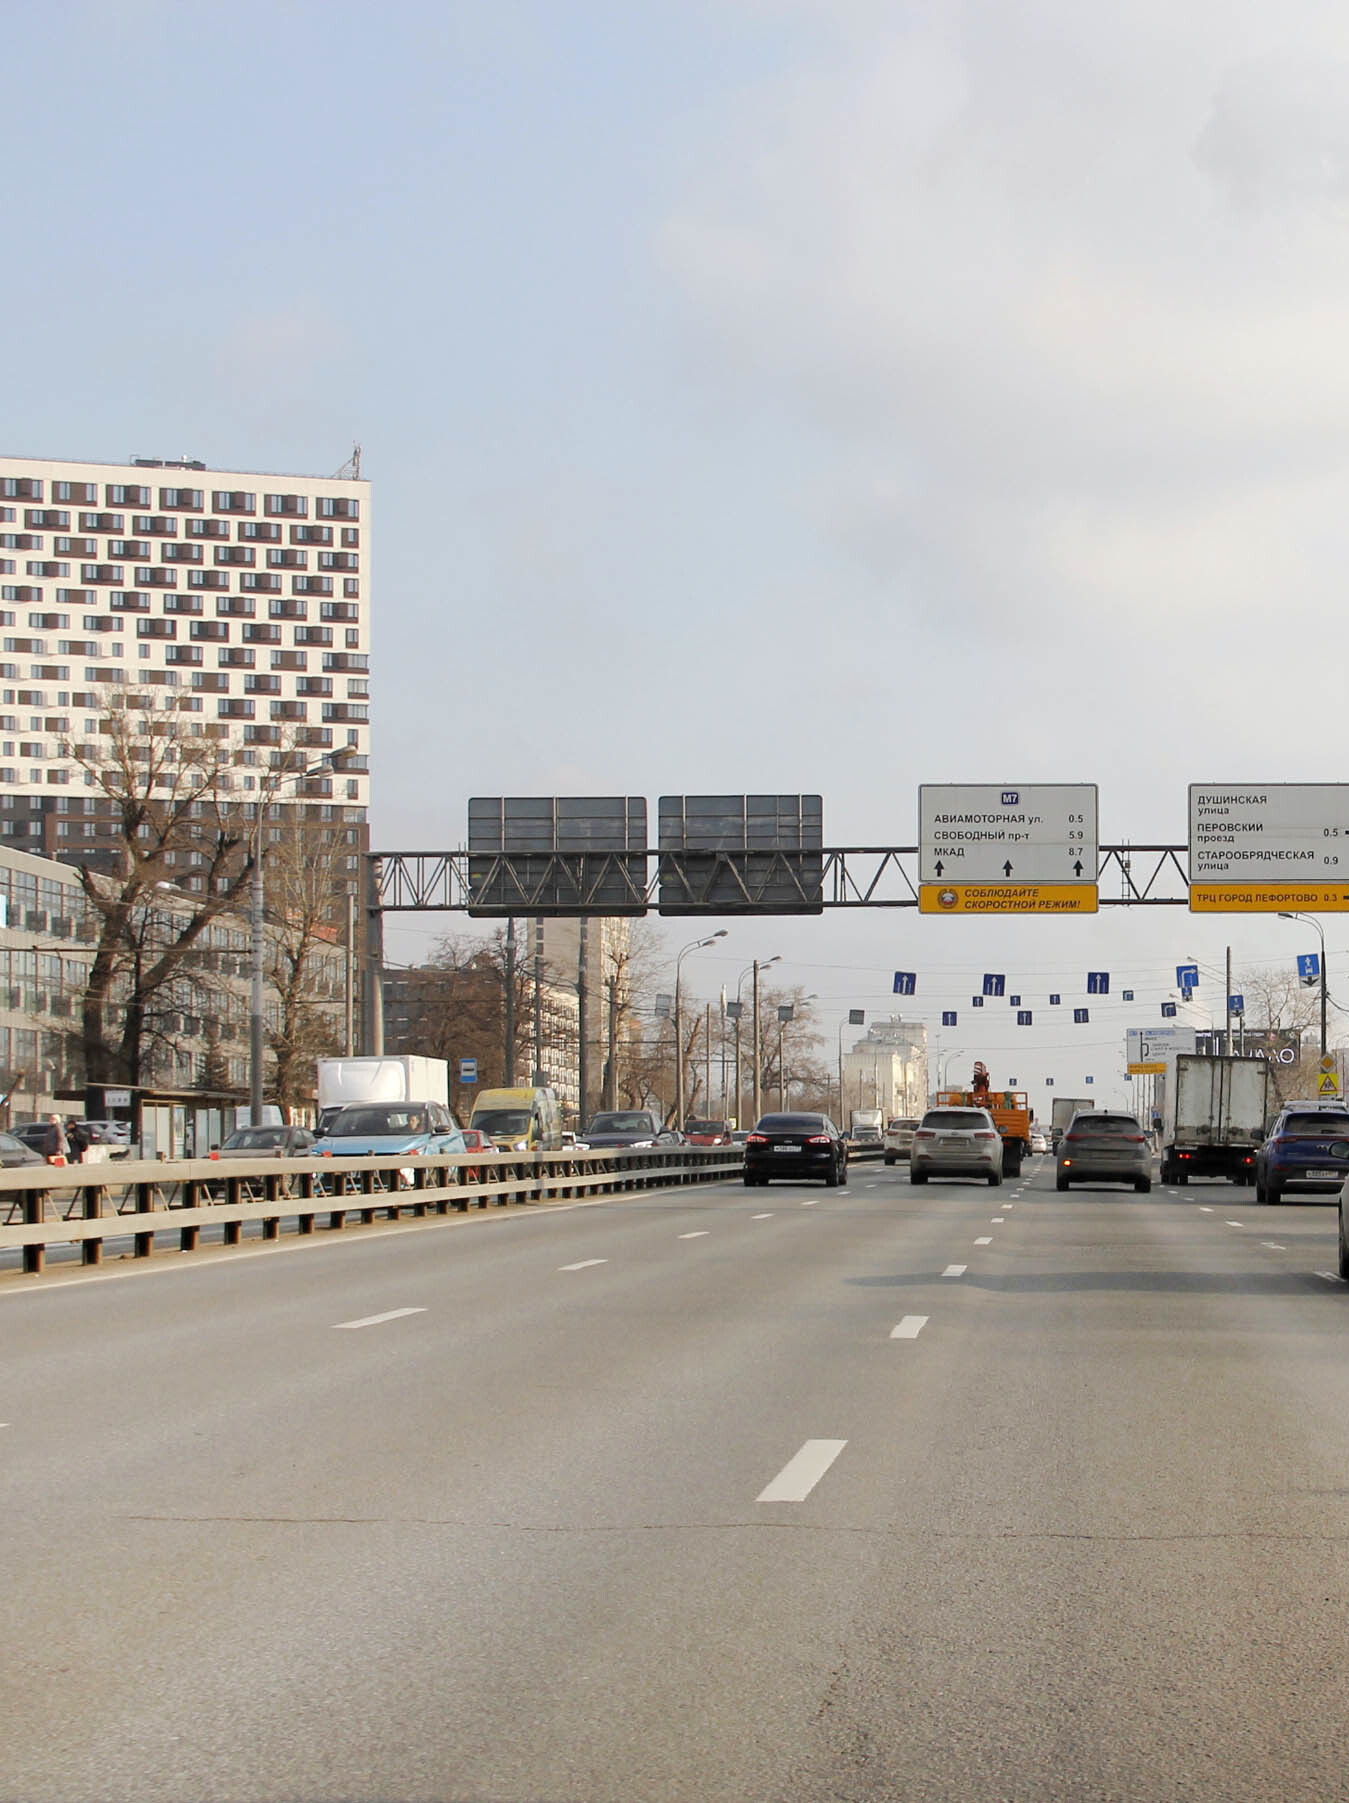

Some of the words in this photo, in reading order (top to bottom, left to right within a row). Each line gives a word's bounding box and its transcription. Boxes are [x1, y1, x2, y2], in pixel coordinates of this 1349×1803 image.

[1198, 795, 1267, 805] ДУШИНСКАЯ
[1198, 807, 1230, 816] улица
[934, 814, 1025, 824] АВИАМОТОРНАЯ
[1028, 816, 1044, 825] ул.
[1068, 814, 1084, 824] 0.5
[934, 830, 1006, 841] СВОБОДНЫЙ
[1008, 832, 1030, 842] пр-т
[1068, 831, 1084, 840] 5.9
[1323, 828, 1339, 837] 0.5
[1197, 834, 1235, 843] проезд
[934, 848, 965, 857] МКАД
[1068, 848, 1084, 857] 8.7
[1198, 851, 1315, 861] СТАРООБРЯДЧЕСКАЯ
[1323, 856, 1339, 865] 0.9
[1198, 862, 1230, 871] улица
[964, 888, 1039, 899] СОБЛЮДАЙТЕ
[1219, 894, 1253, 903] ГОРОД
[964, 899, 1036, 909] СКОРОСТНОЙ
[1038, 900, 1081, 909] РЕЖИМ!
